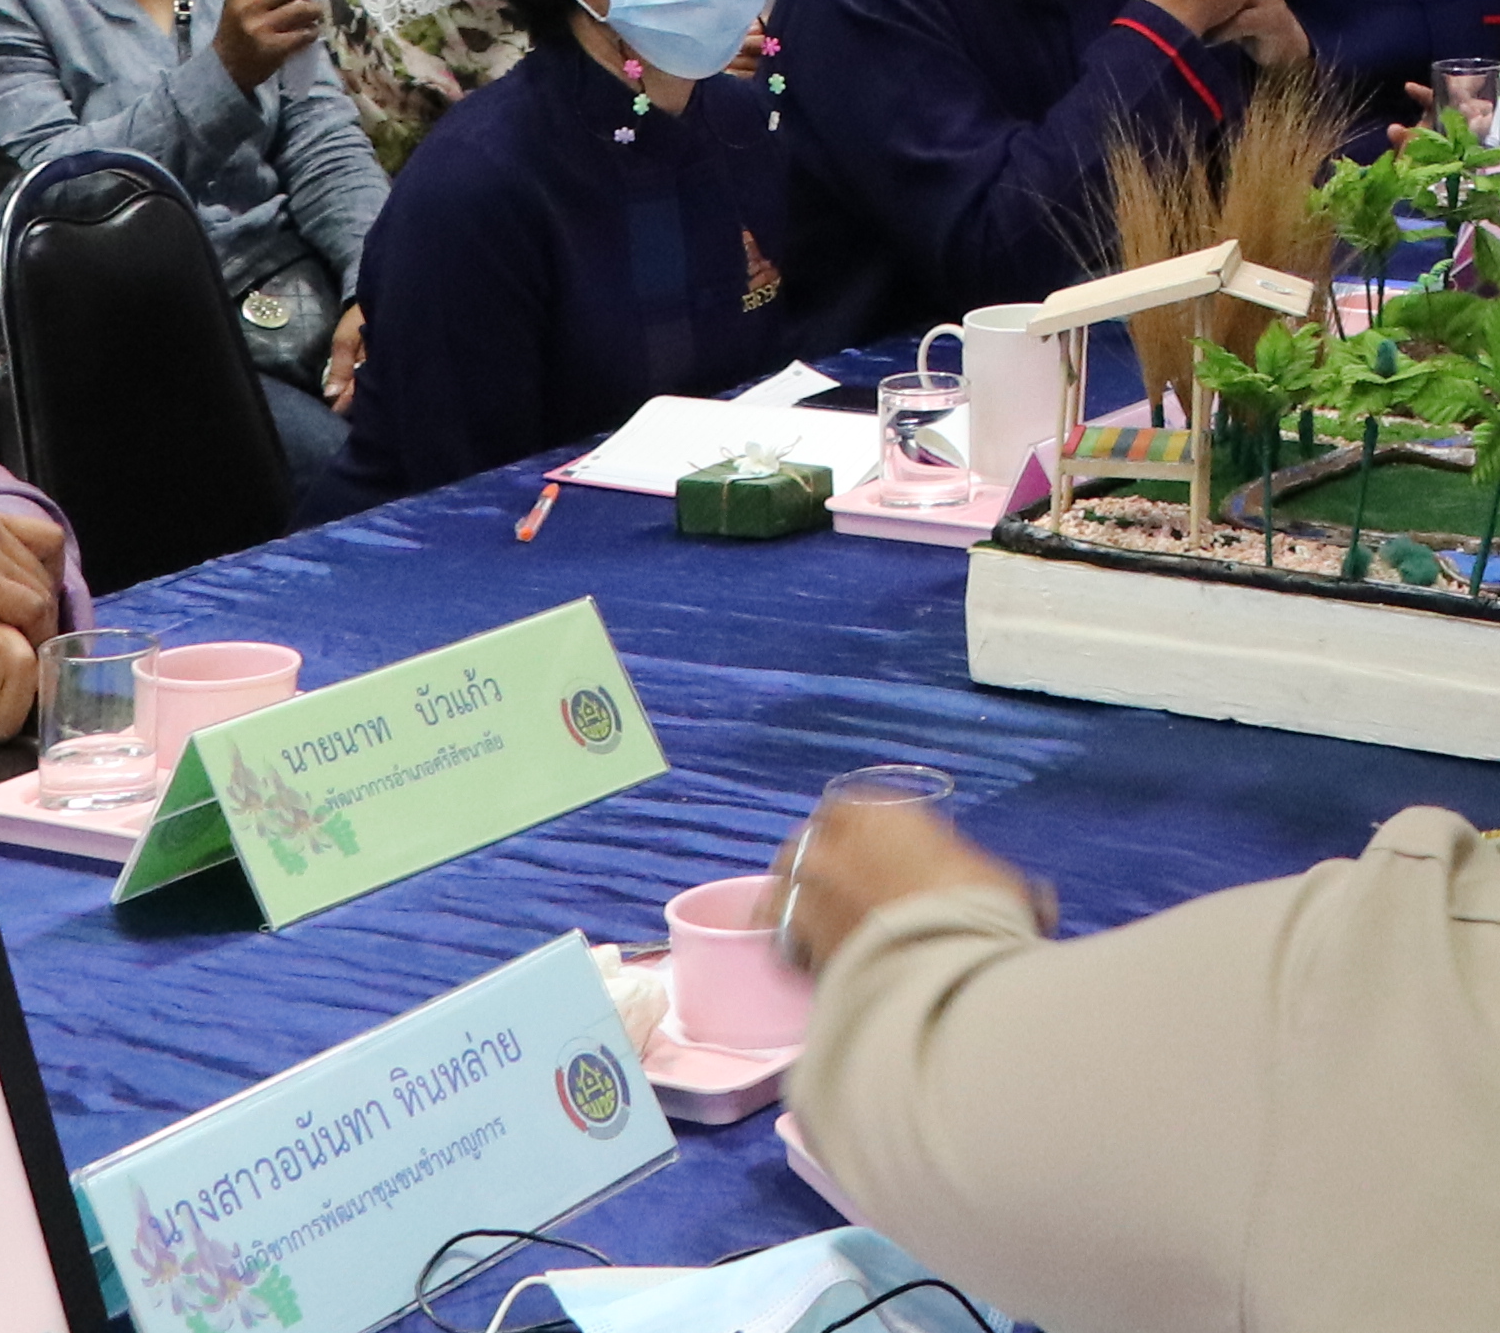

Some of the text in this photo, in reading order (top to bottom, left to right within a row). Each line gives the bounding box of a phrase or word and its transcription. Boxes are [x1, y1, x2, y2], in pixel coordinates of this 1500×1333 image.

[281, 669, 505, 775] นายนาท บัวแก้ว
[148, 1024, 523, 1251] นางสาวอนันทา หินหล่าย
